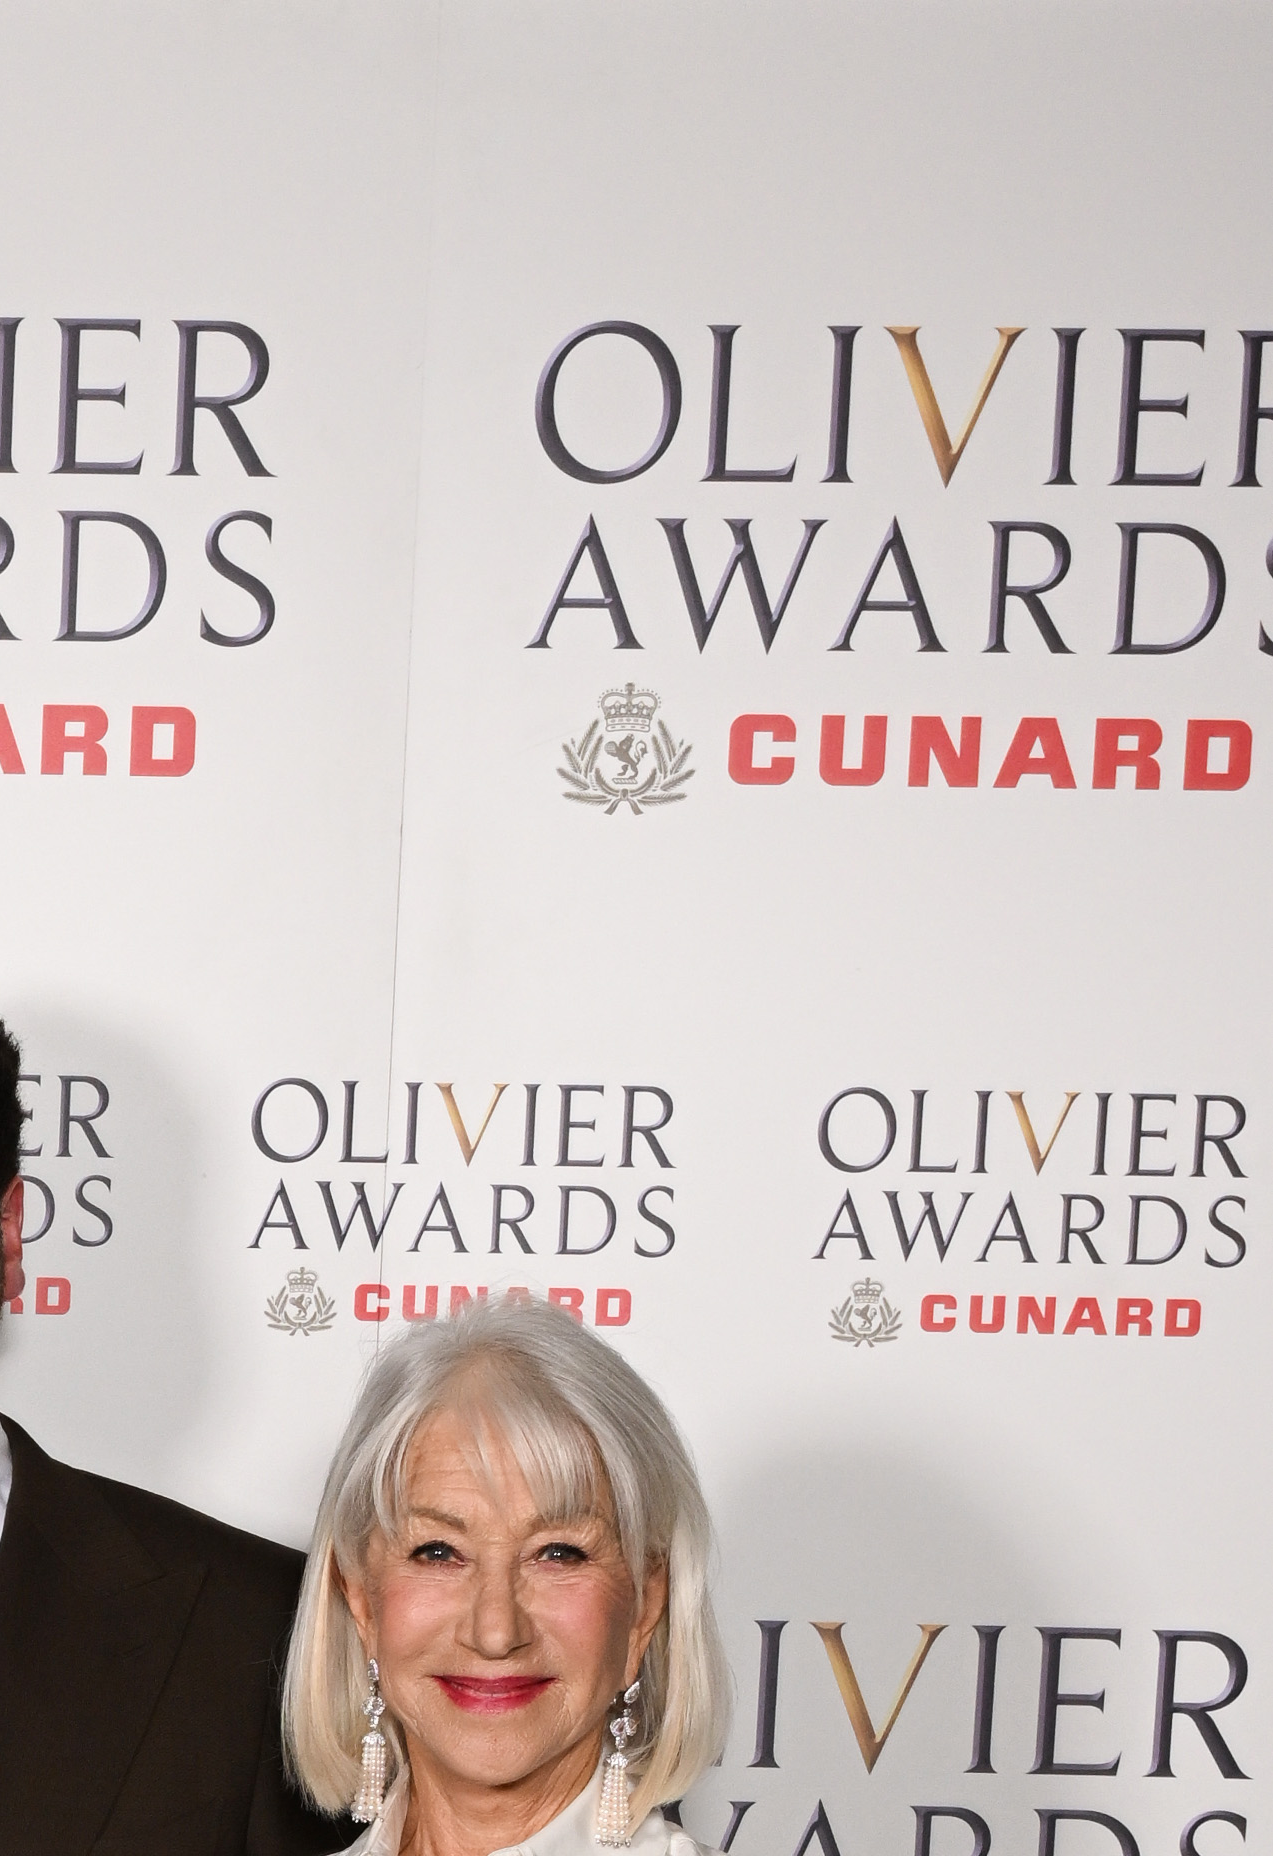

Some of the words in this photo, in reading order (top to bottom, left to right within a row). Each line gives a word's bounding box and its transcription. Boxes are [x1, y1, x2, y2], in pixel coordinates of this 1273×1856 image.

[524, 513, 1273, 656] AWARD
[727, 713, 1253, 791] CUNARD
[250, 1077, 677, 1169] OLIVIER
[817, 1086, 1249, 1179] OLIVIER
[246, 1177, 676, 1259] AWARDS
[811, 1187, 1247, 1269] AWARDS
[920, 1293, 1202, 1337] CUNARD
[746, 1619, 1255, 1780] IVIER
